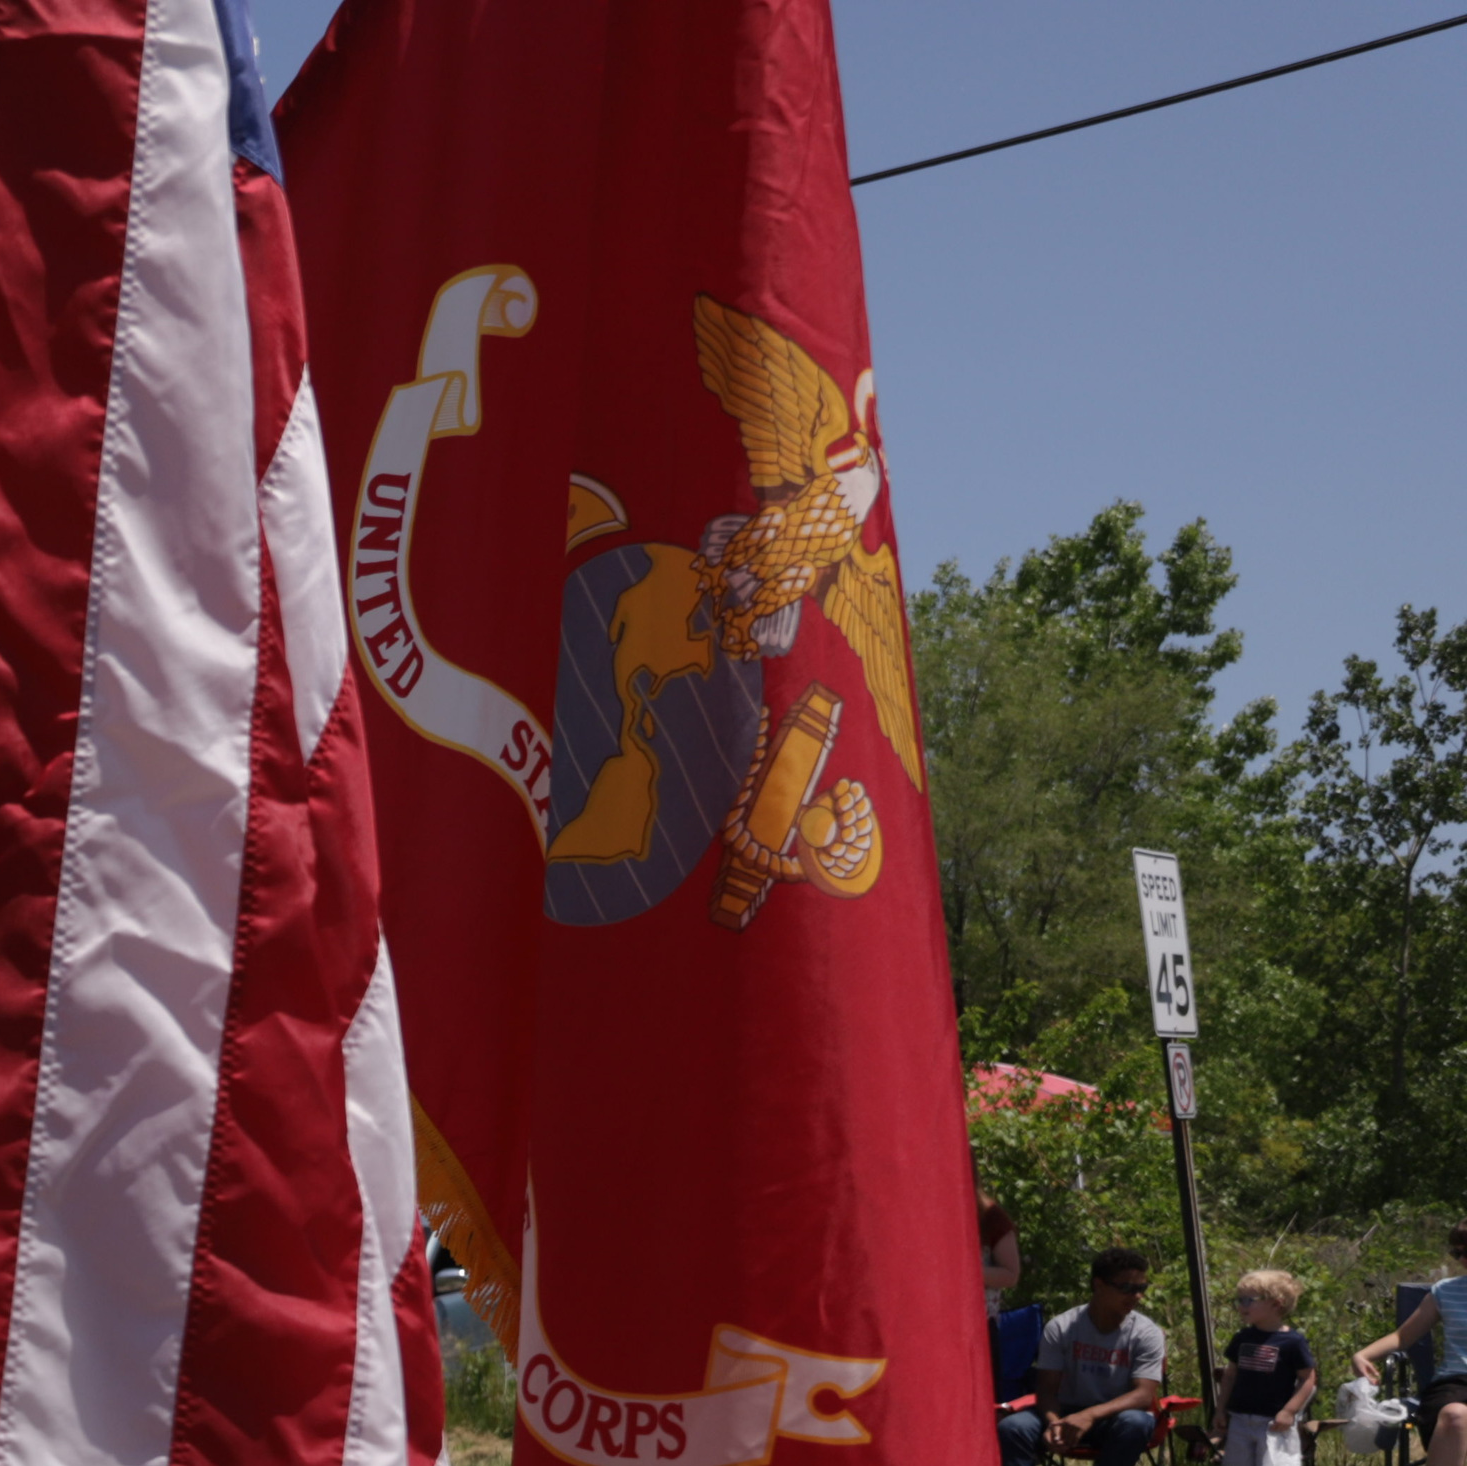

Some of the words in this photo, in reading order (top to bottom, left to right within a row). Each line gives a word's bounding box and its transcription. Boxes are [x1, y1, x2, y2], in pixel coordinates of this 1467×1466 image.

[356, 472, 424, 698] UNITED
[499, 720, 551, 834] ST
[1141, 872, 1177, 902] SPEED
[1149, 910, 1178, 939] LIMIT
[1156, 952, 1190, 1017] 45
[522, 1353, 686, 1460] CORPS
